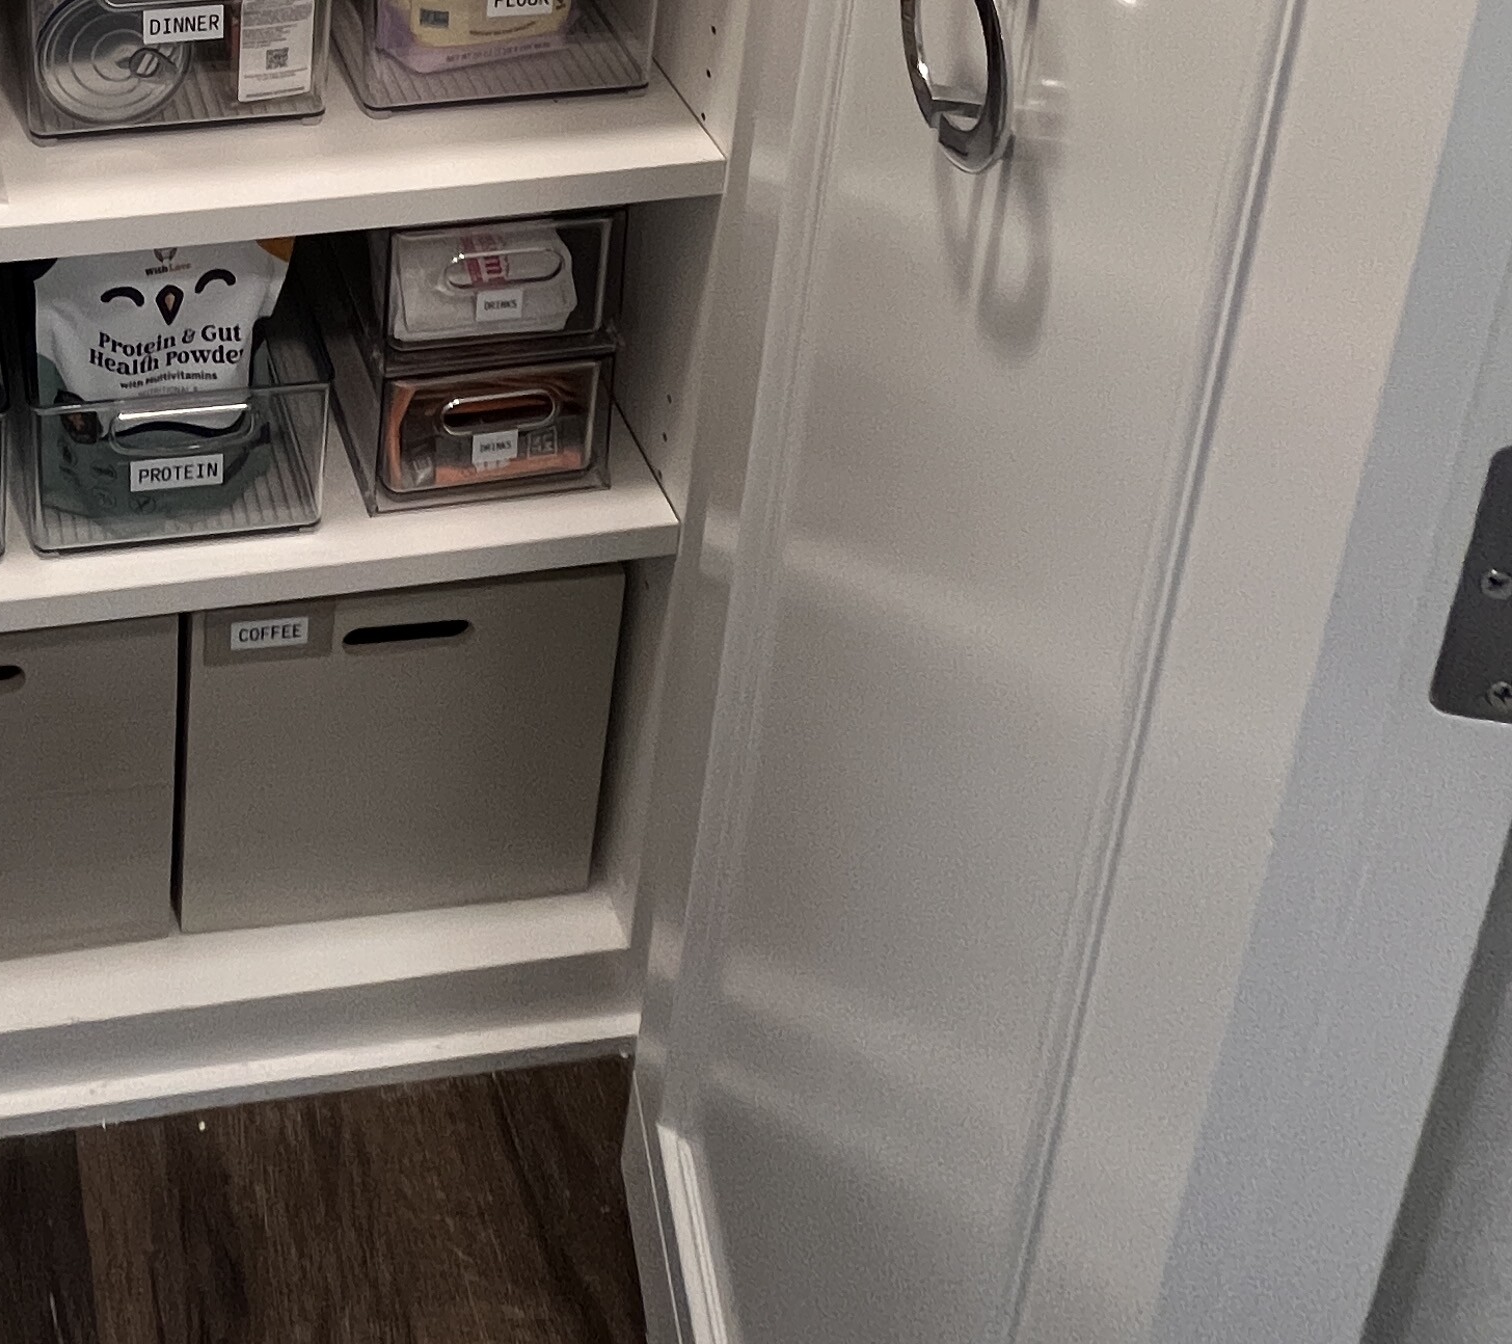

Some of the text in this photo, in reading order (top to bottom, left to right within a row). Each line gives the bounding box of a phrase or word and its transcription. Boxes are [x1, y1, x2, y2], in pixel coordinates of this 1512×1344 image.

[149, 13, 220, 35] DINNER
[484, 299, 518, 311] DRINKS
[98, 324, 242, 357] Protein & Gut
[89, 348, 159, 376] Health
[120, 370, 218, 390] with multivitamins
[479, 439, 512, 453] DRINKS
[138, 462, 218, 484] PROTEIN
[238, 624, 302, 642] COFFEE
